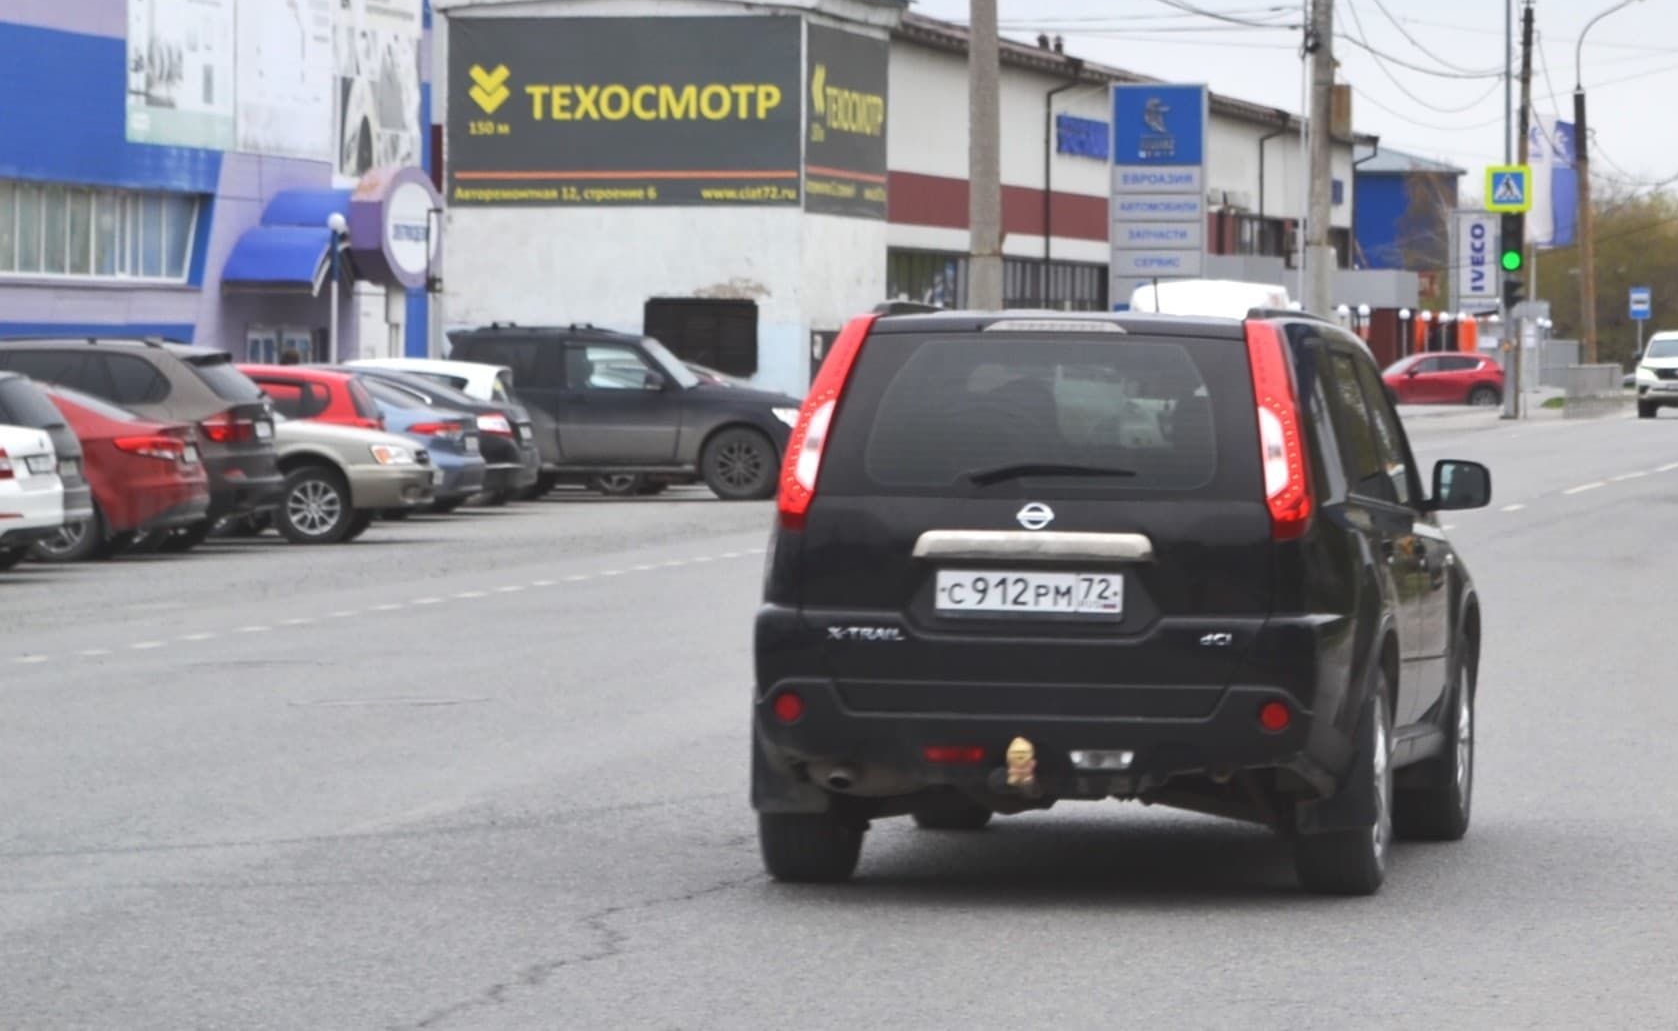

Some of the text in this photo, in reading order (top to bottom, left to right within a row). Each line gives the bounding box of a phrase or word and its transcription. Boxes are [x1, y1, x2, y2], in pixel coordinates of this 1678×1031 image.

[525, 83, 782, 121] ТЕХОСМОТР
[469, 122, 494, 136] 150
[1121, 173, 1193, 186] ЕВРОАЗИЯ
[454, 186, 558, 201] Авторемонтная
[583, 188, 645, 201] строение
[1119, 202, 1197, 212] АВТОМОБИЛИ
[1128, 230, 1188, 240] ЗАПЧАСТИ
[1133, 257, 1181, 267] СЕРВИС
[1471, 223, 1486, 293] IVECO
[826, 625, 906, 641] X-TRAIL
